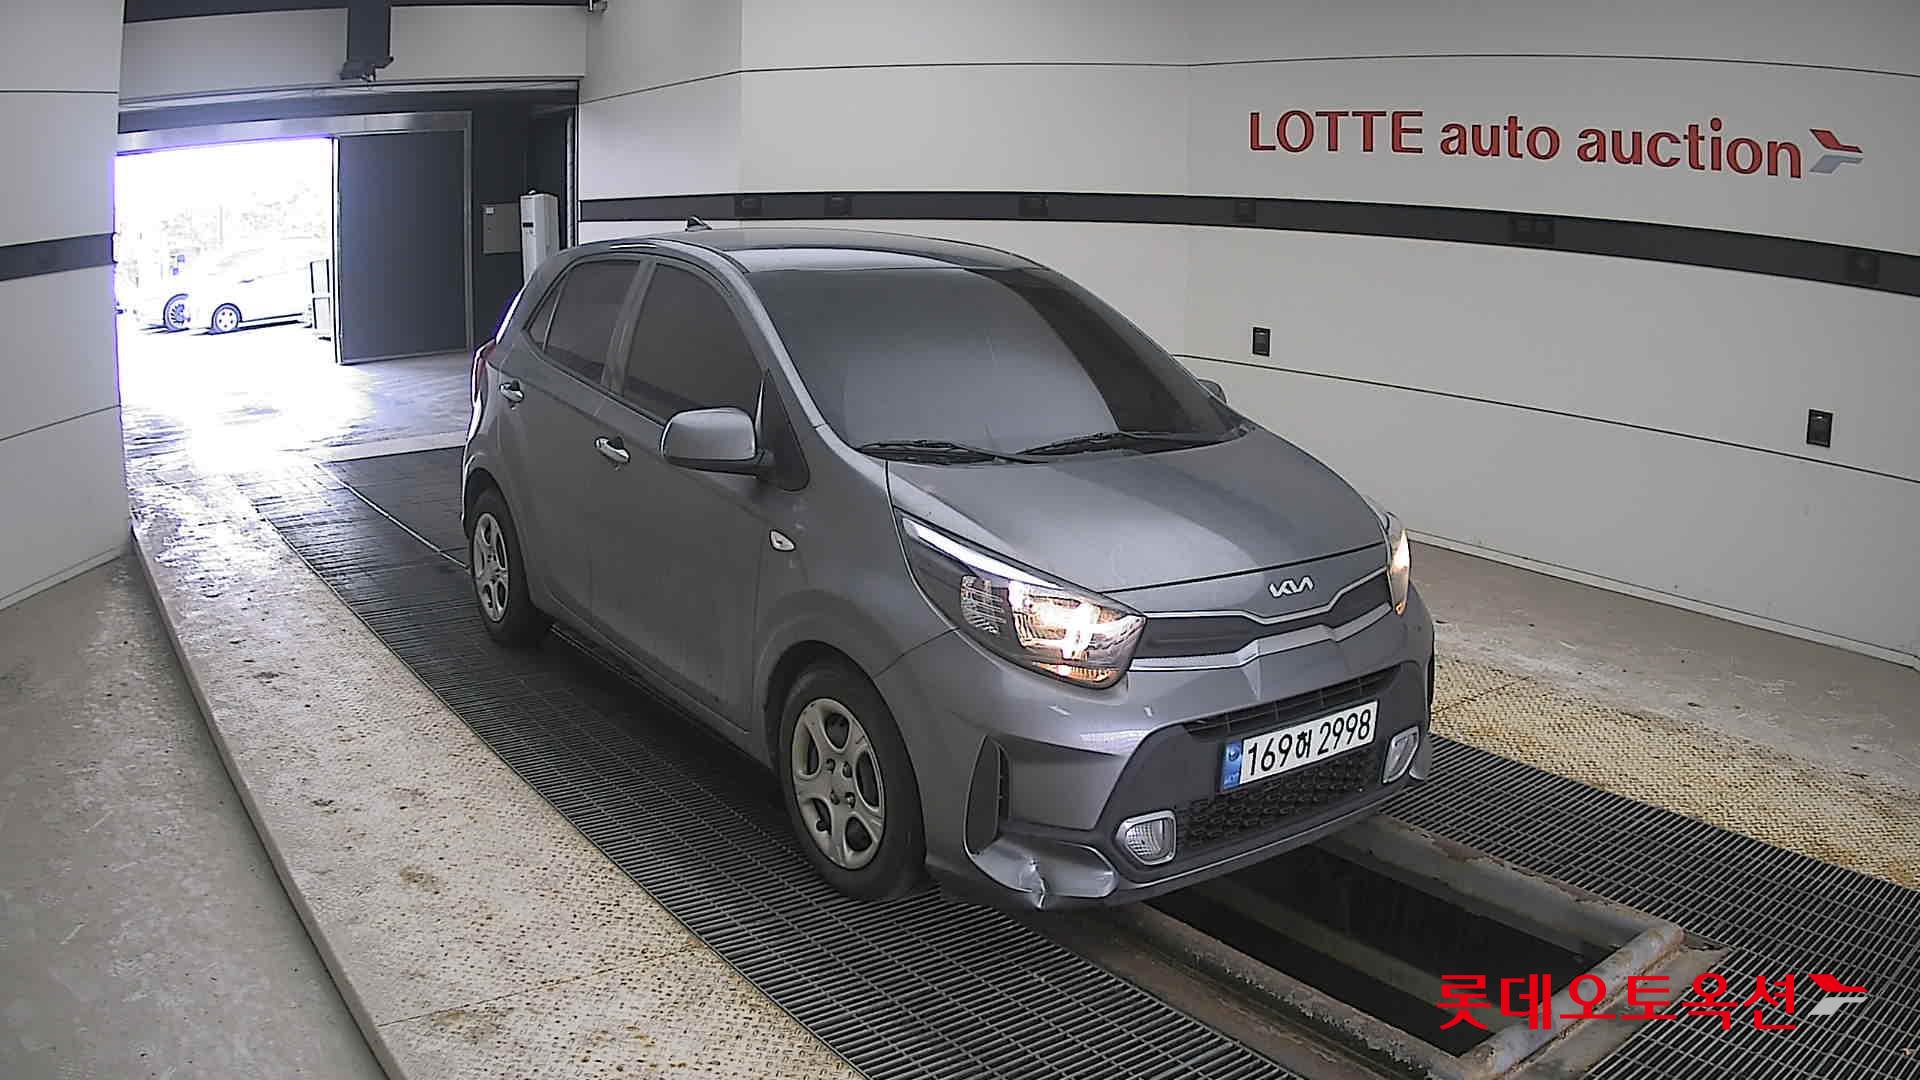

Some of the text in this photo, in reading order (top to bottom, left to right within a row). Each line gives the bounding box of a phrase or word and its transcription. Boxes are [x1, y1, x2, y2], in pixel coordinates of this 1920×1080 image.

[1249, 110, 1802, 179] LOTTE auto auction
[1269, 576, 1314, 598] KIA
[1317, 708, 1371, 756] 2998
